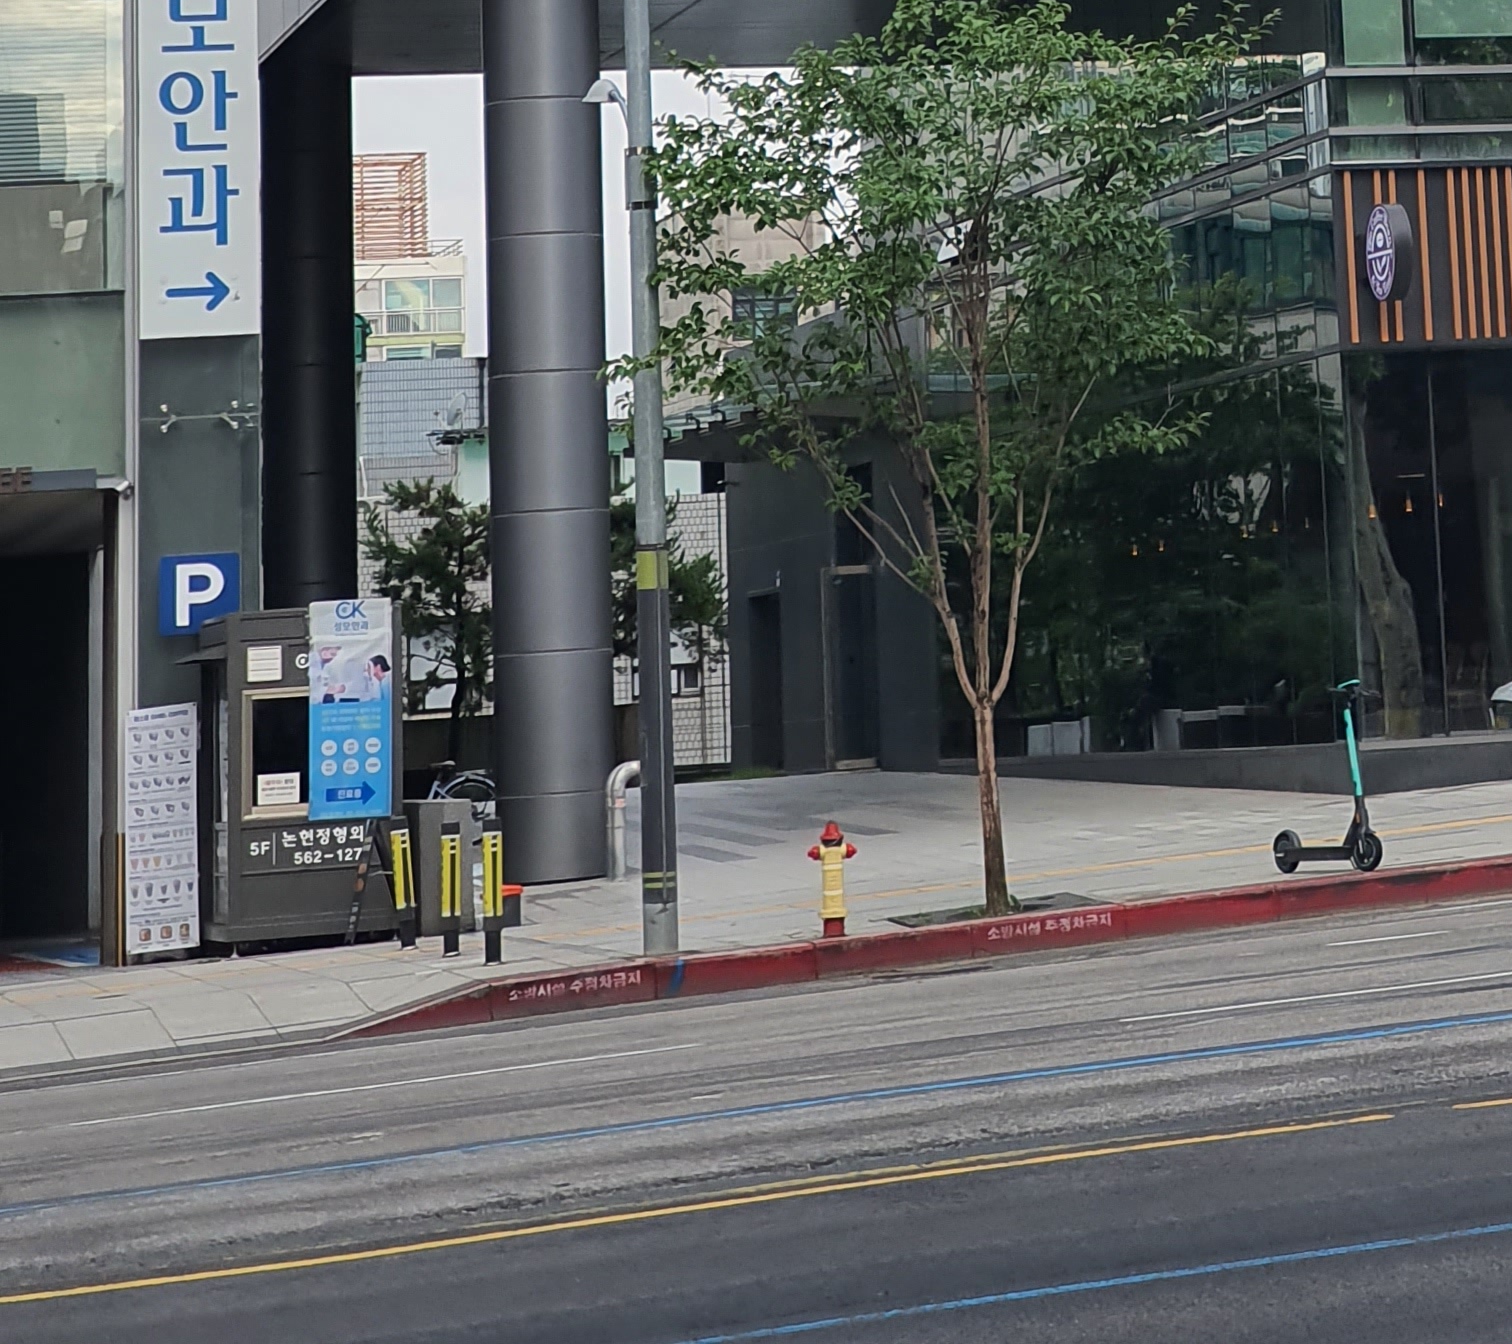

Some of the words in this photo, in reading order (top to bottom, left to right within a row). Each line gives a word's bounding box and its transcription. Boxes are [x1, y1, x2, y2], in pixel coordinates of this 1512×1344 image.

[174, 563, 225, 627] P
[335, 600, 367, 620] CK
[249, 840, 271, 856] 5F
[281, 824, 365, 848] 논현정형외
[293, 847, 364, 865] 562-127
